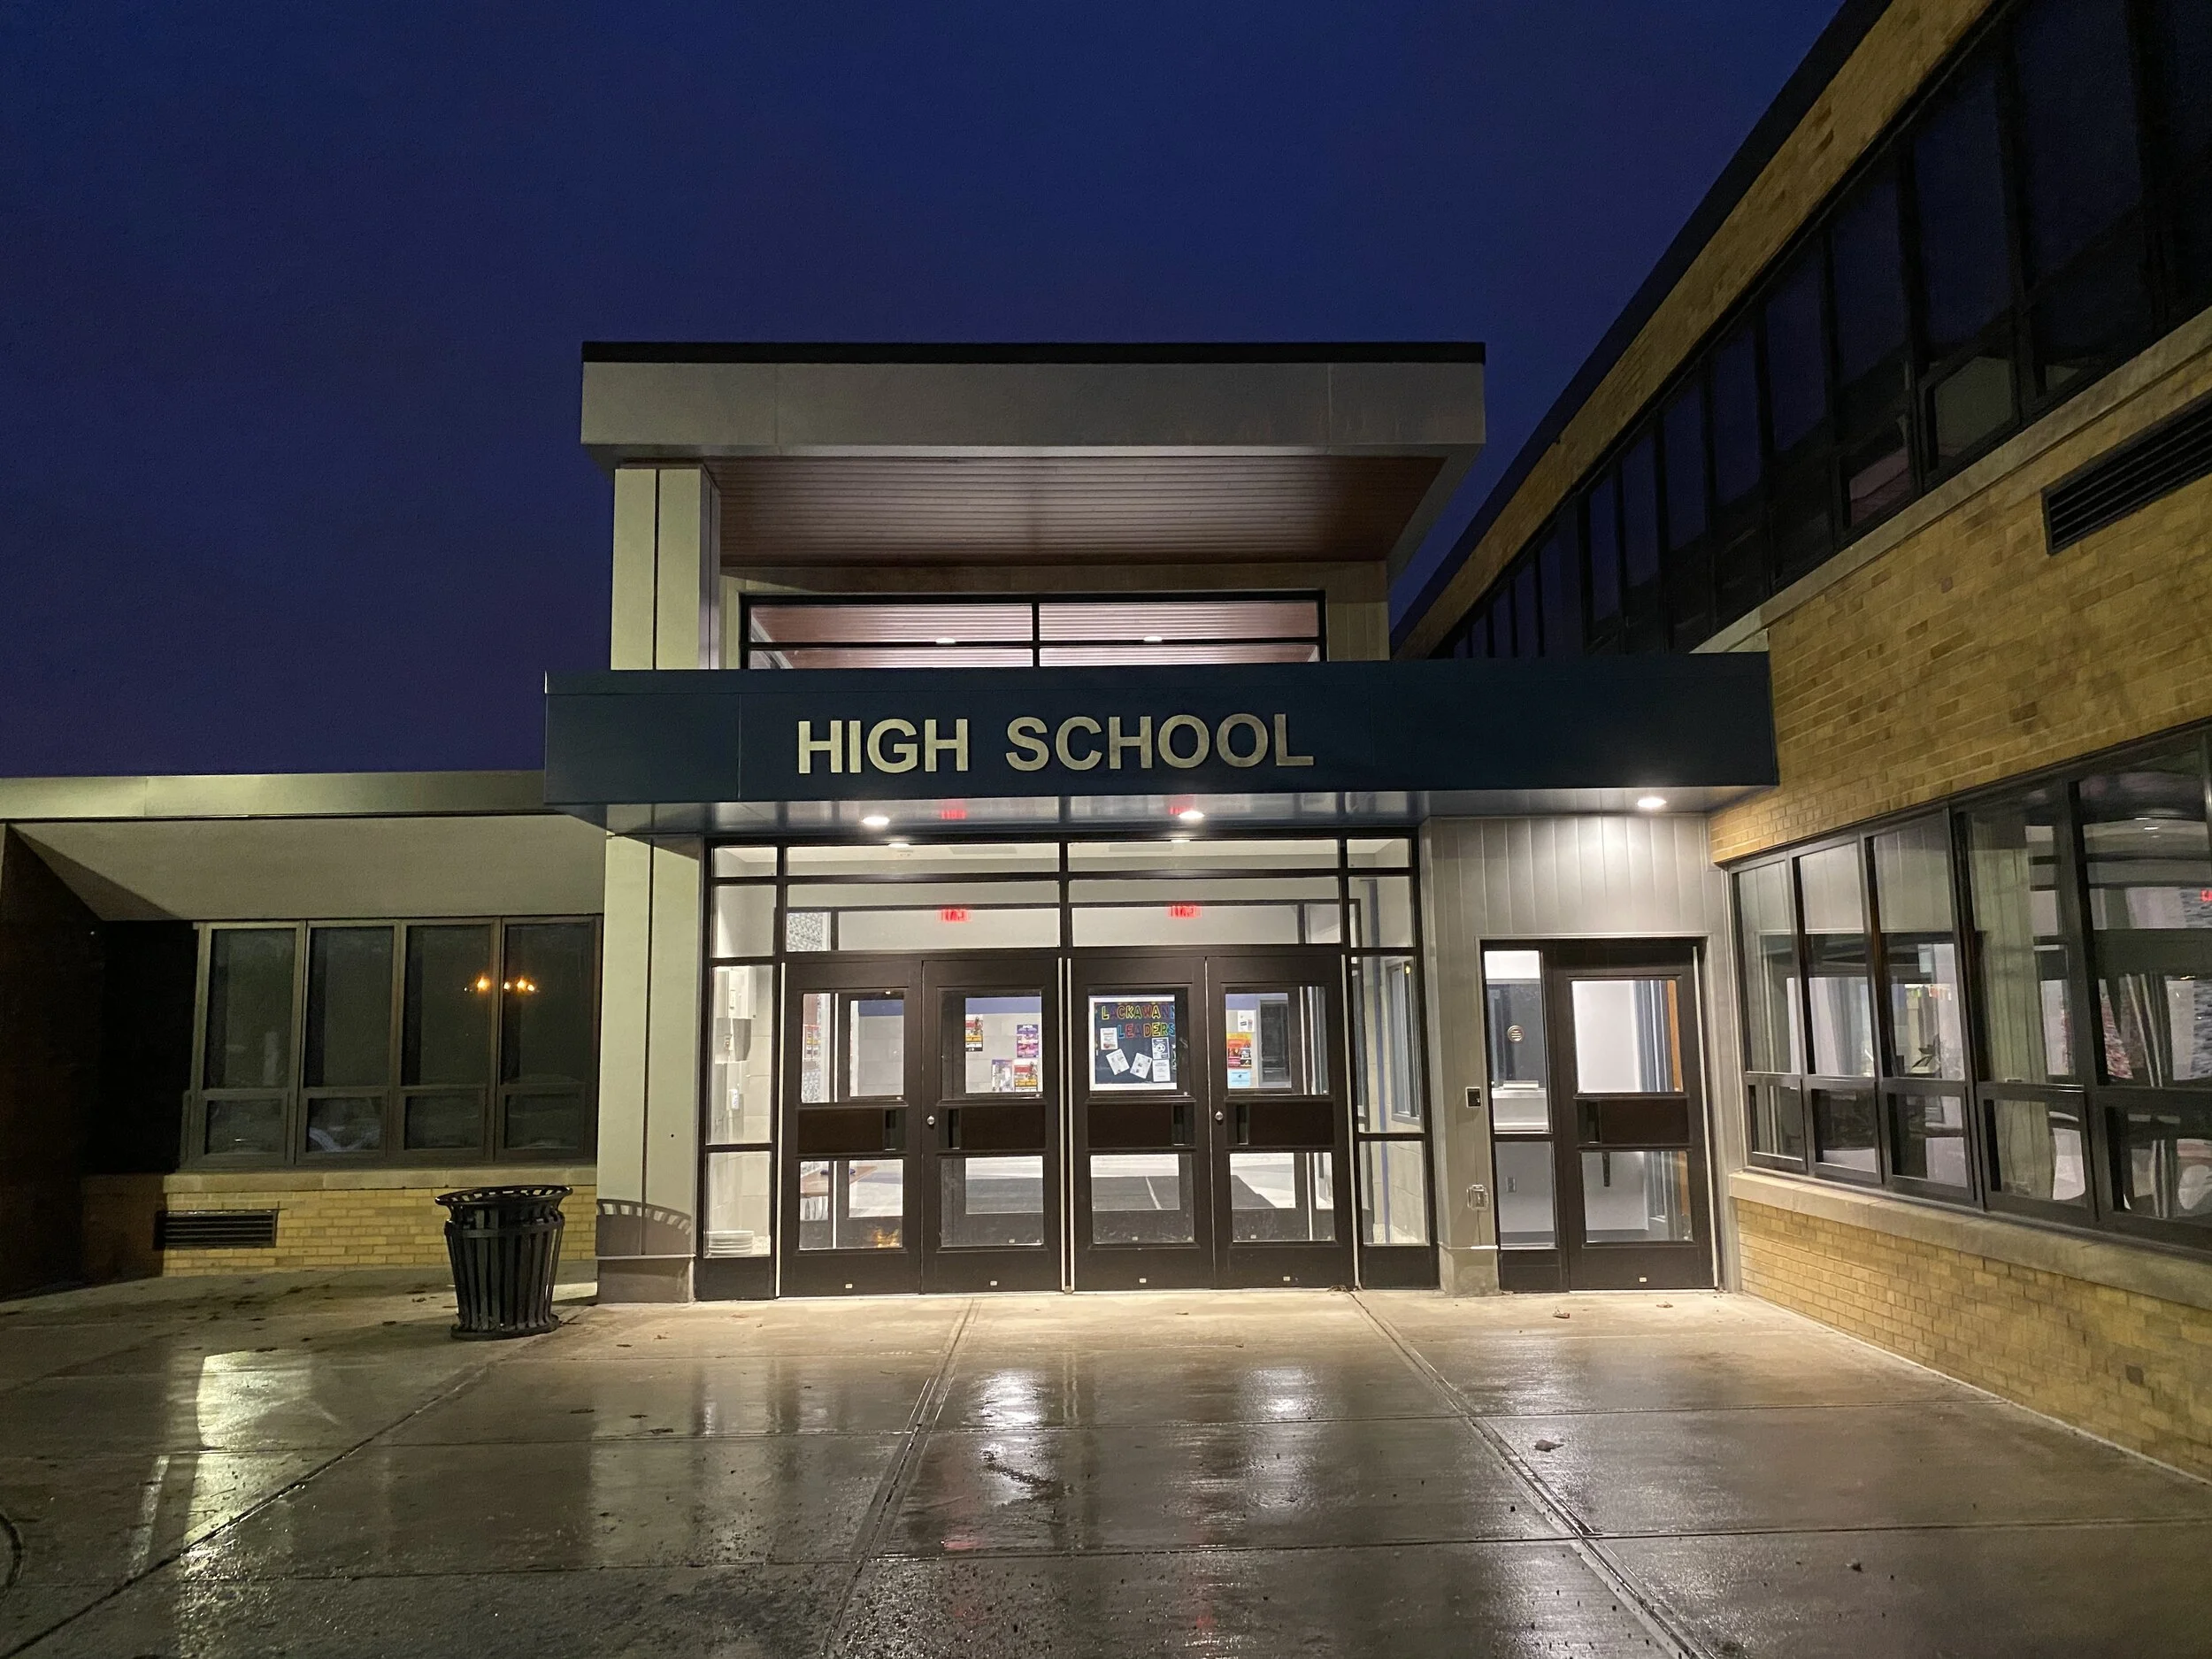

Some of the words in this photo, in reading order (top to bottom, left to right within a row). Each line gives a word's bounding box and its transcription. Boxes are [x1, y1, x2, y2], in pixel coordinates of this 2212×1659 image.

[798, 718, 968, 774] HIGH
[1005, 713, 1314, 772] SCHOOL
[1118, 1022, 1175, 1039] LEADERS
